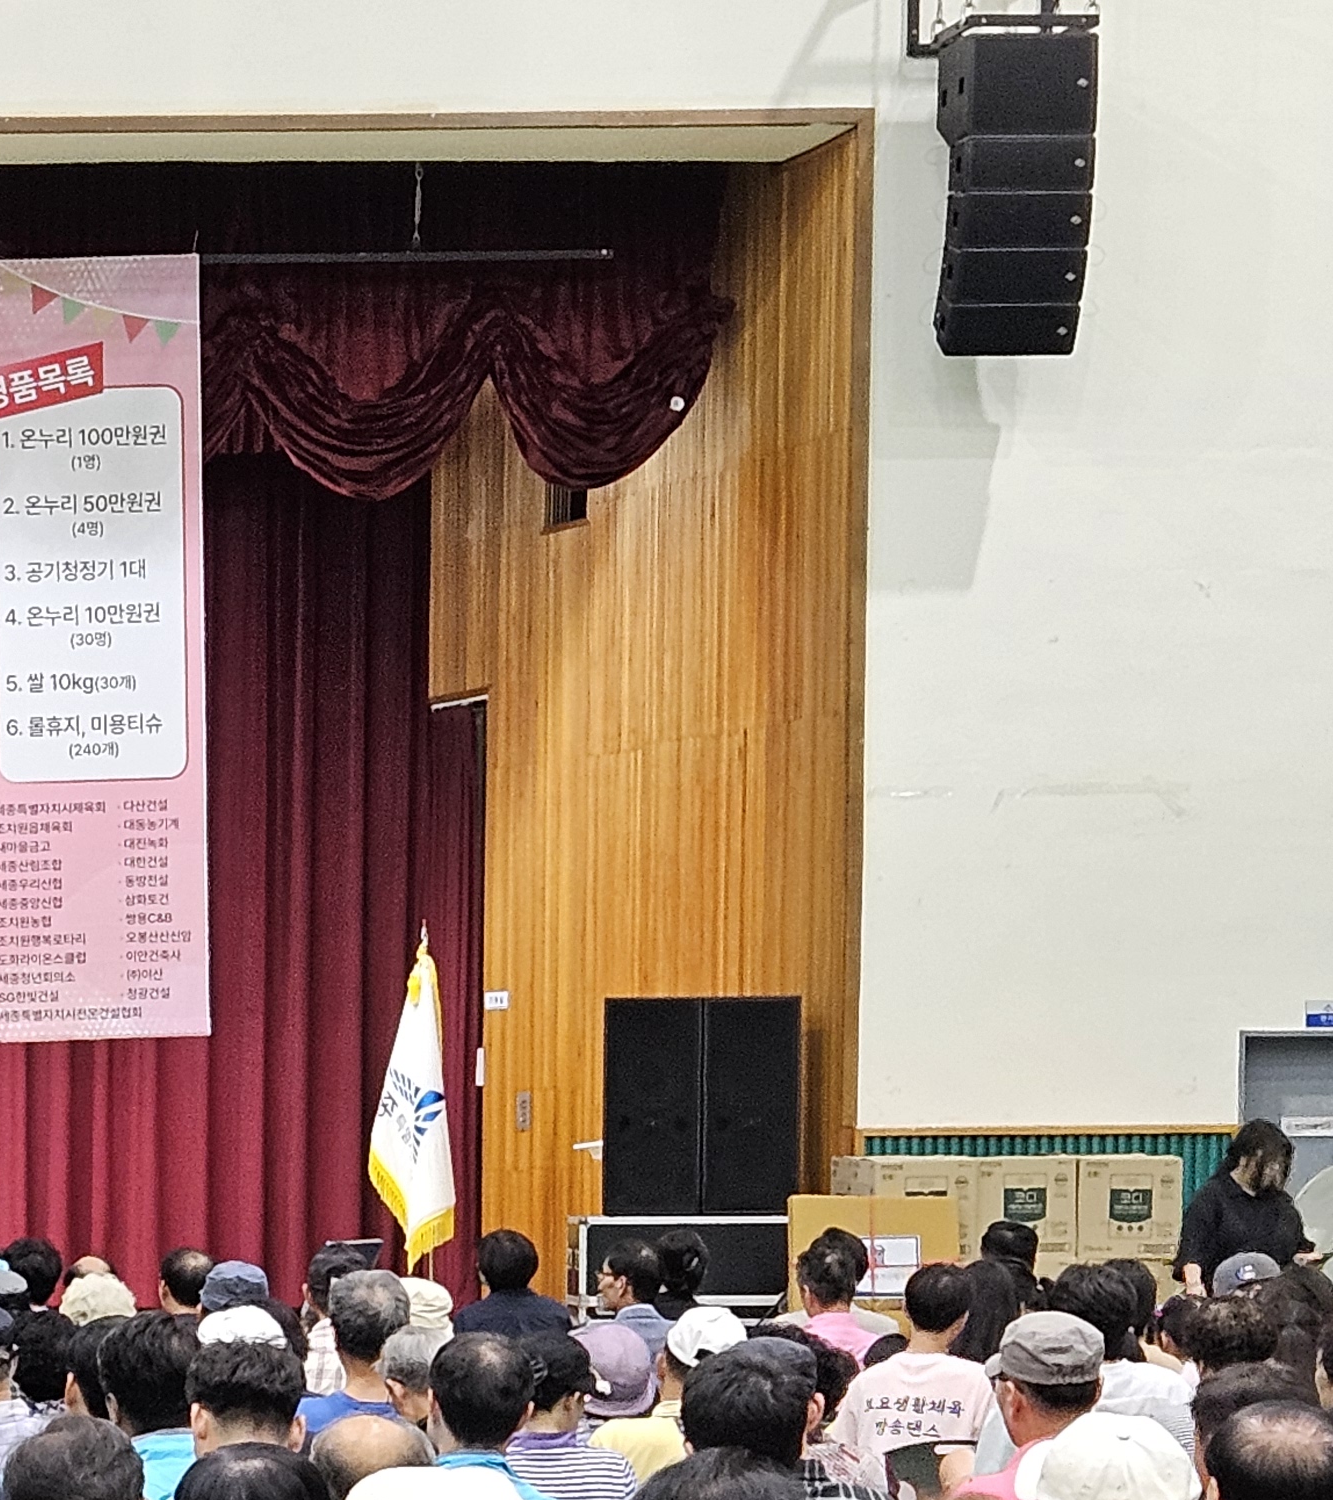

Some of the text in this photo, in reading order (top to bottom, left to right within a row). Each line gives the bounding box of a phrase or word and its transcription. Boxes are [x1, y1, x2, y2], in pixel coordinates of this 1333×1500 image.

[1, 424, 167, 450] 1. 온누리 100만원권
[2, 490, 162, 516] 2. 온누리 50만원권
[71, 520, 104, 539] (4명)
[4, 558, 147, 583] 3. 공기청정기 1대
[4, 602, 161, 627] 4. 온누리 10만원권
[70, 631, 112, 650] (30명)
[5, 672, 137, 695] 5. 쌀 10kg(30개)
[6, 712, 164, 739] 6. 롤휴지, 미용티슈
[68, 741, 120, 760] (240개)
